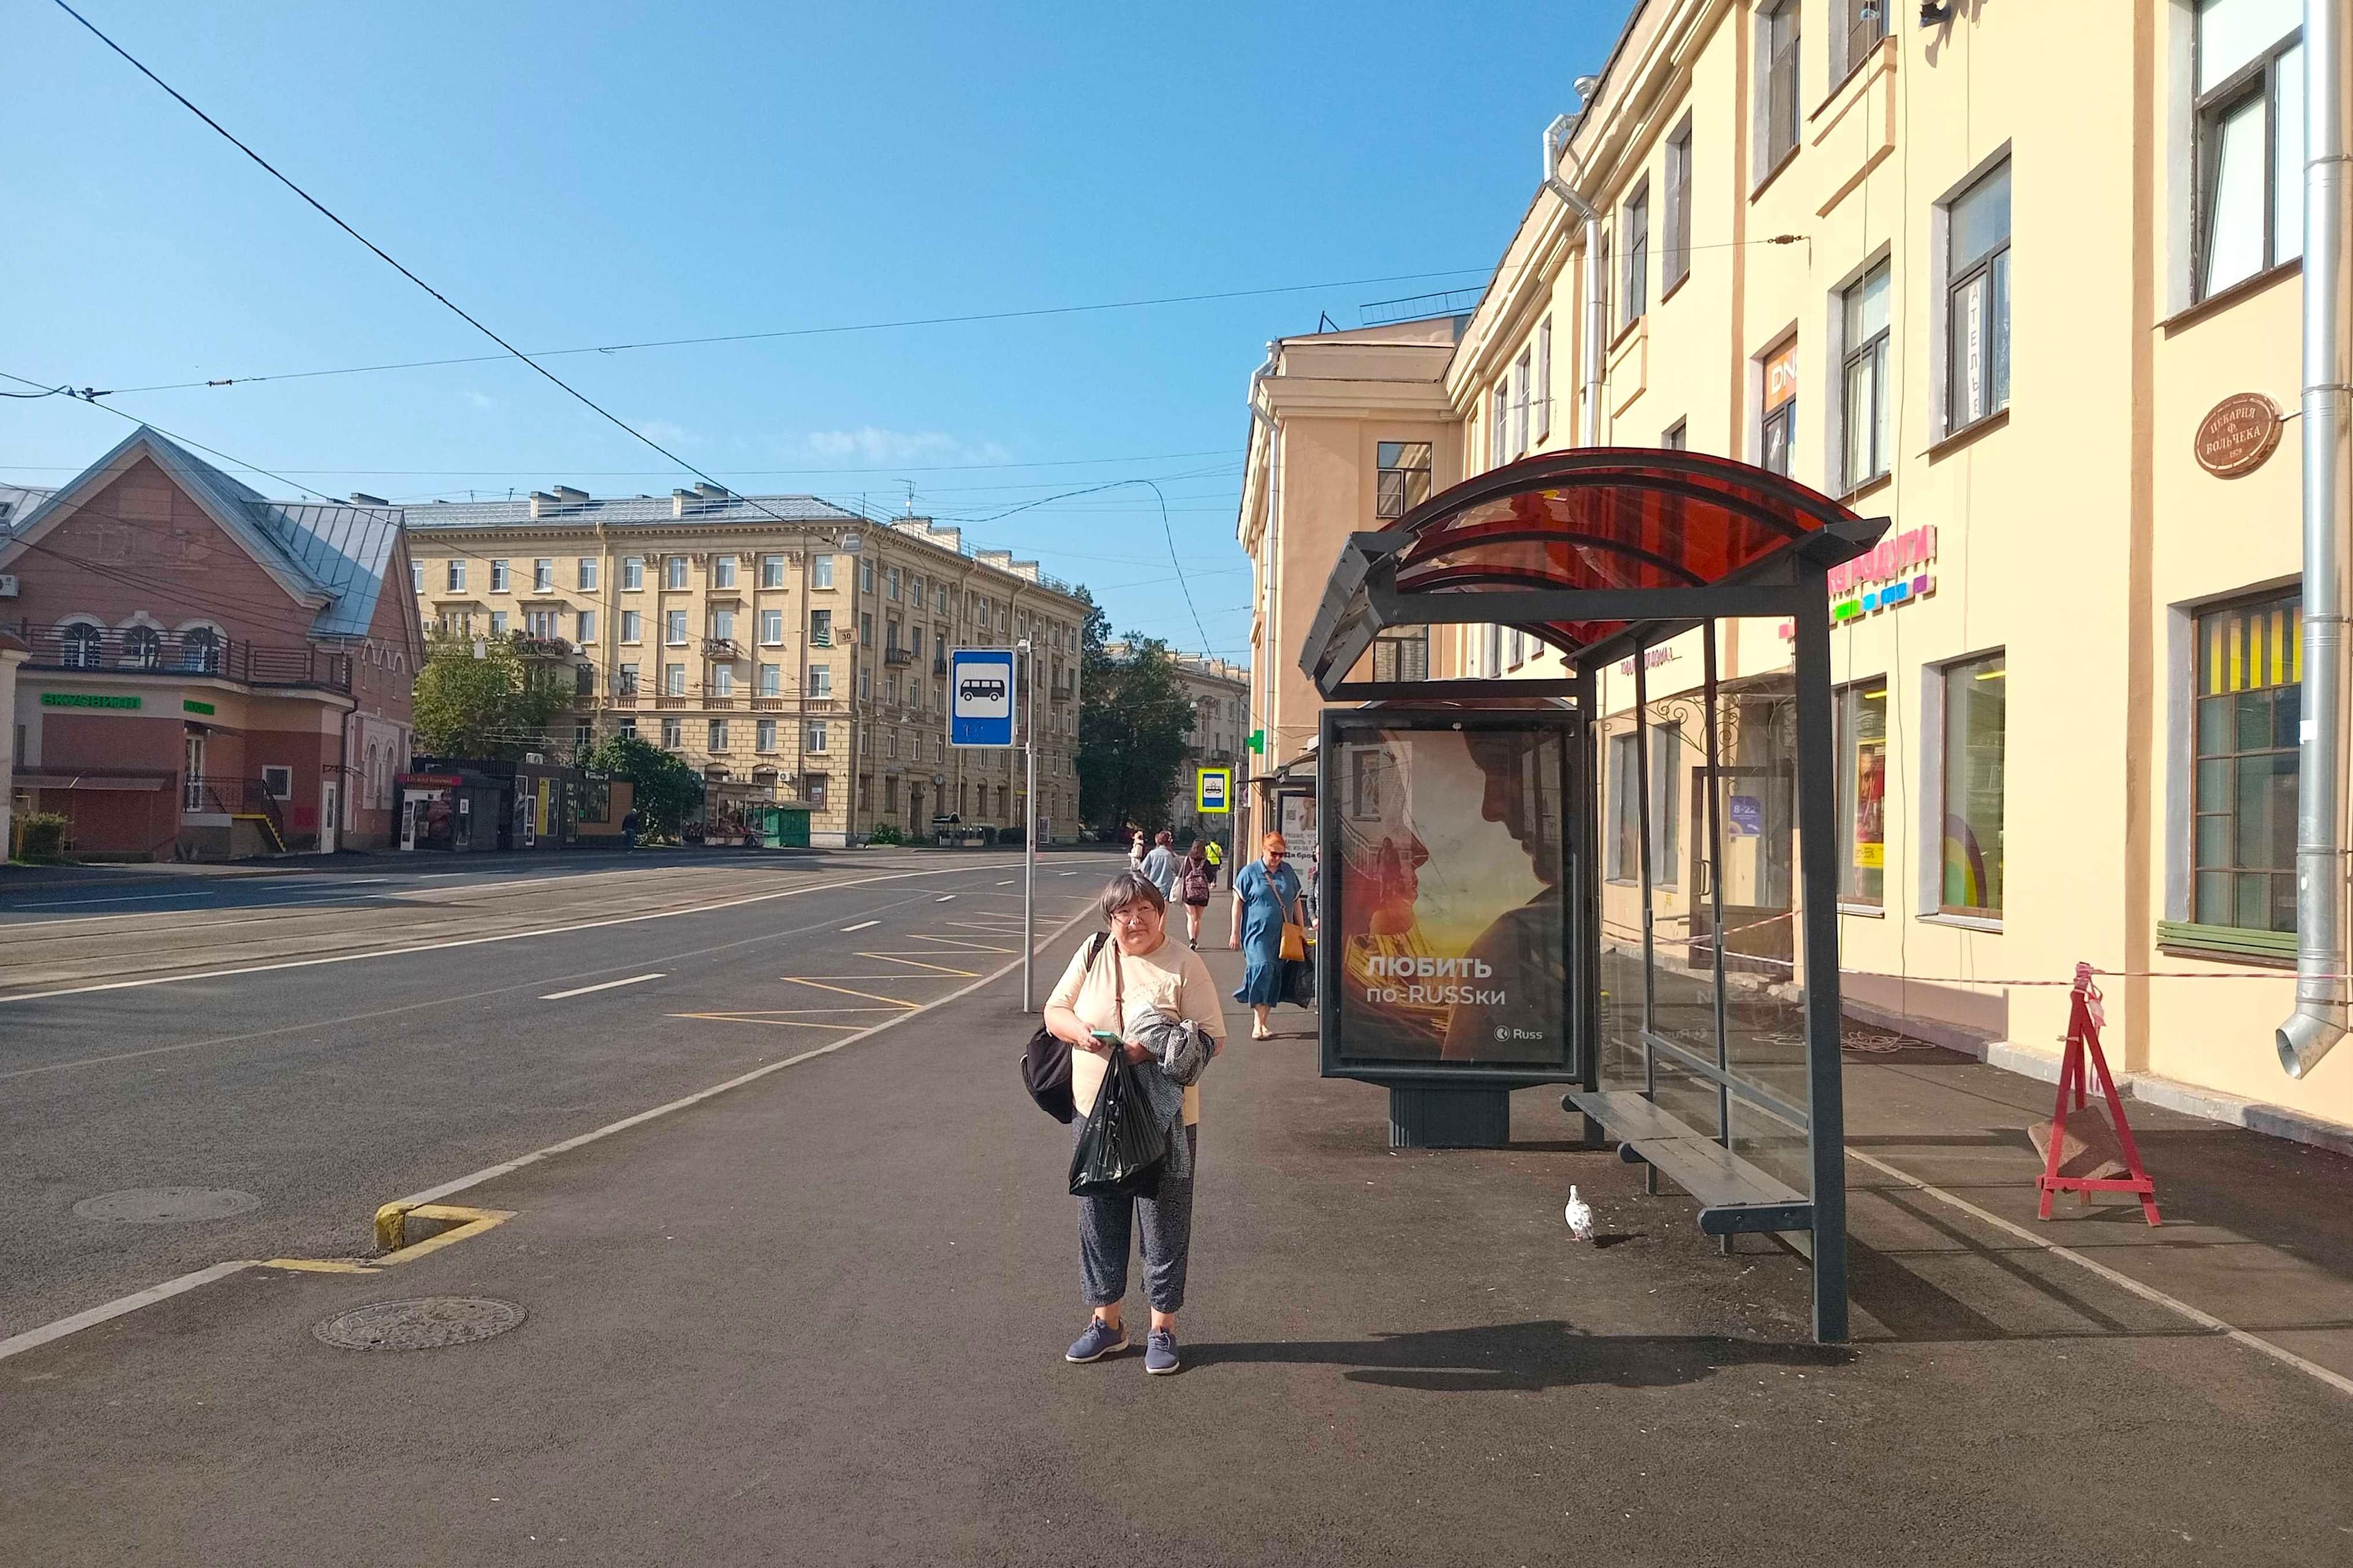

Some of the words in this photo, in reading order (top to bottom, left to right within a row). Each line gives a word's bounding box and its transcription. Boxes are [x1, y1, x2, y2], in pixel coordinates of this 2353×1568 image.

[1970, 284, 1980, 414] АТЕЛЬЕ
[2210, 407, 2256, 434] ПЕКАРНЯ
[2206, 425, 2261, 455] ВОЛЬЧЕКА
[1733, 805, 1757, 814] 8-22
[1366, 956, 1493, 979] ЛЮБИТЬ
[1366, 985, 1506, 1005] по-RUSSки
[1513, 1028, 1543, 1040] Russ
